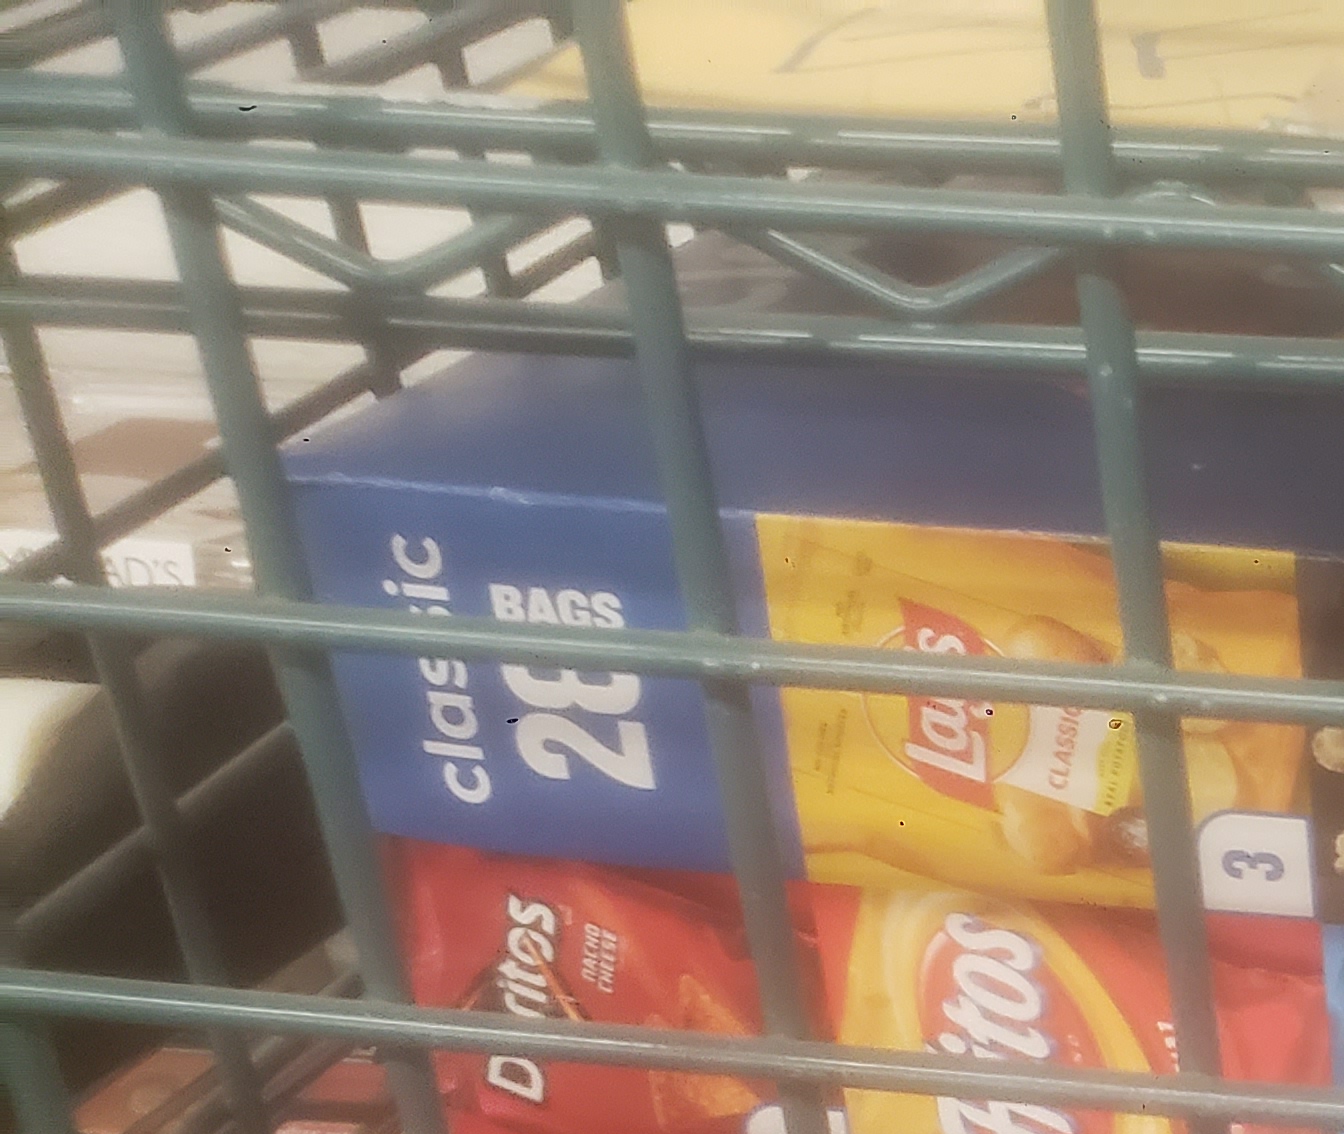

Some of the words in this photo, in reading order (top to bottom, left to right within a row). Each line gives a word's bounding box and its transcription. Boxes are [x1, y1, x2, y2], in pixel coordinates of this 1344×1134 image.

[488, 583, 625, 629] BAGS
[383, 533, 491, 805] clasic
[1222, 849, 1284, 882] 3
[597, 928, 618, 994] CHEESE
[486, 893, 559, 1103] Dritos
